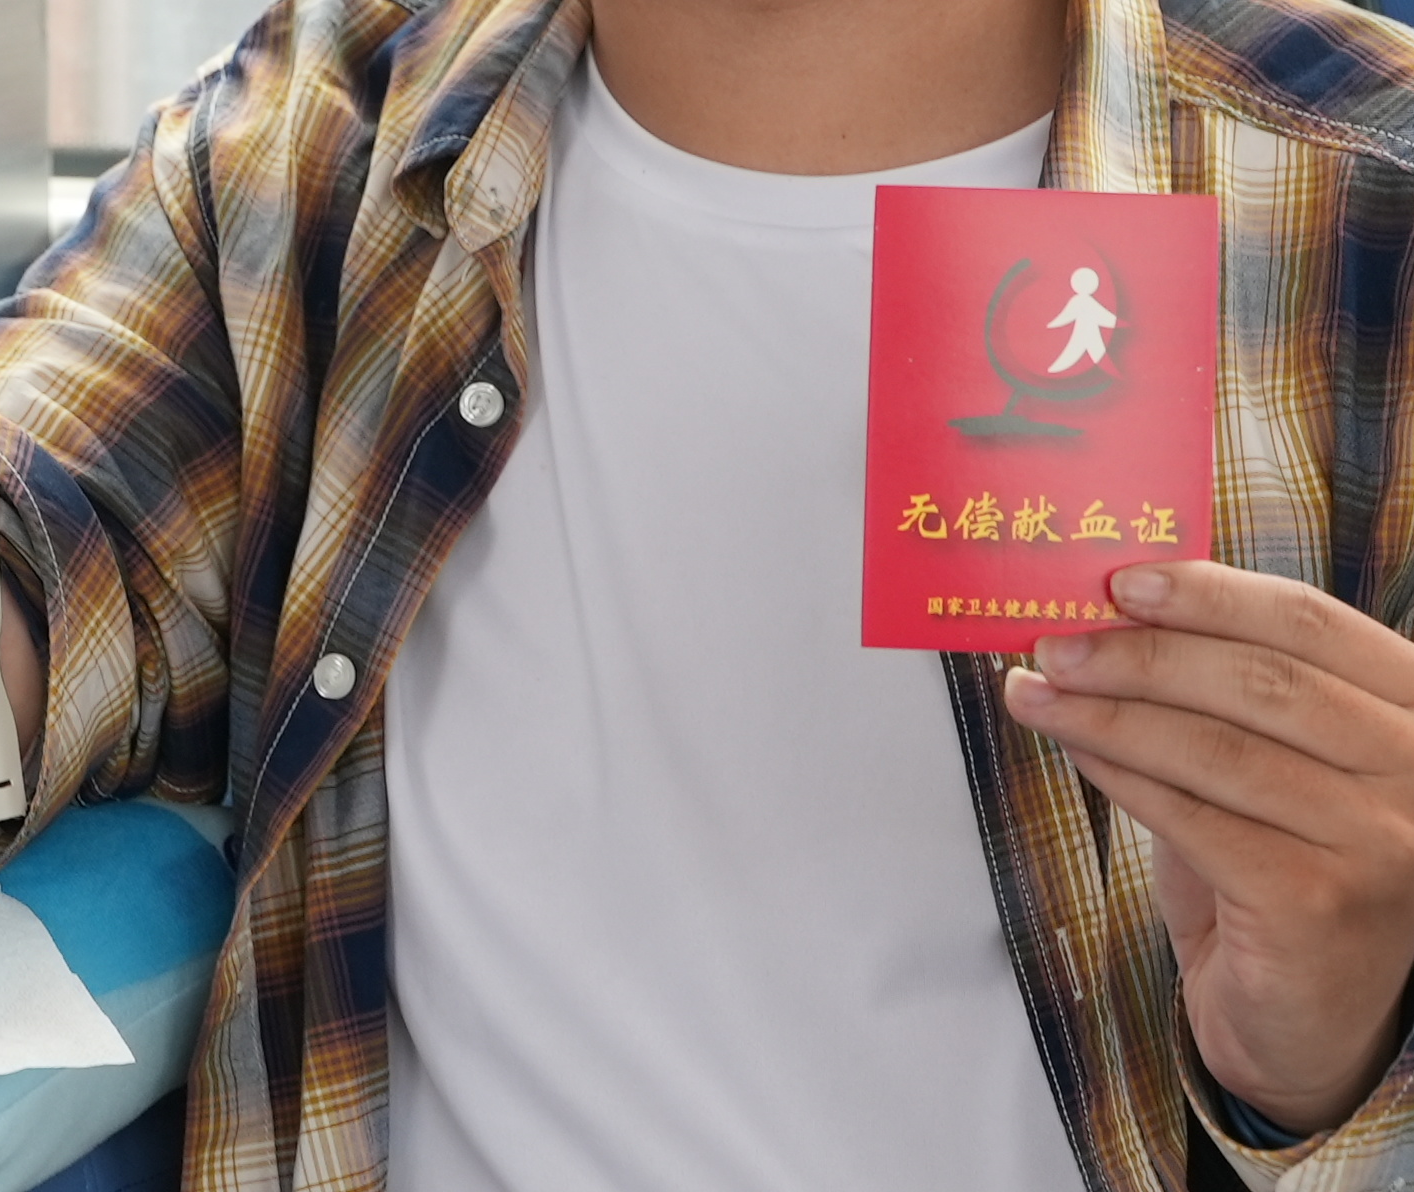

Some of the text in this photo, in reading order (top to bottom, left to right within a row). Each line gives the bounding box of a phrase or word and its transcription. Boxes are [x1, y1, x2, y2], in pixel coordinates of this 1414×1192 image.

[897, 492, 1179, 544] 无偿献血证
